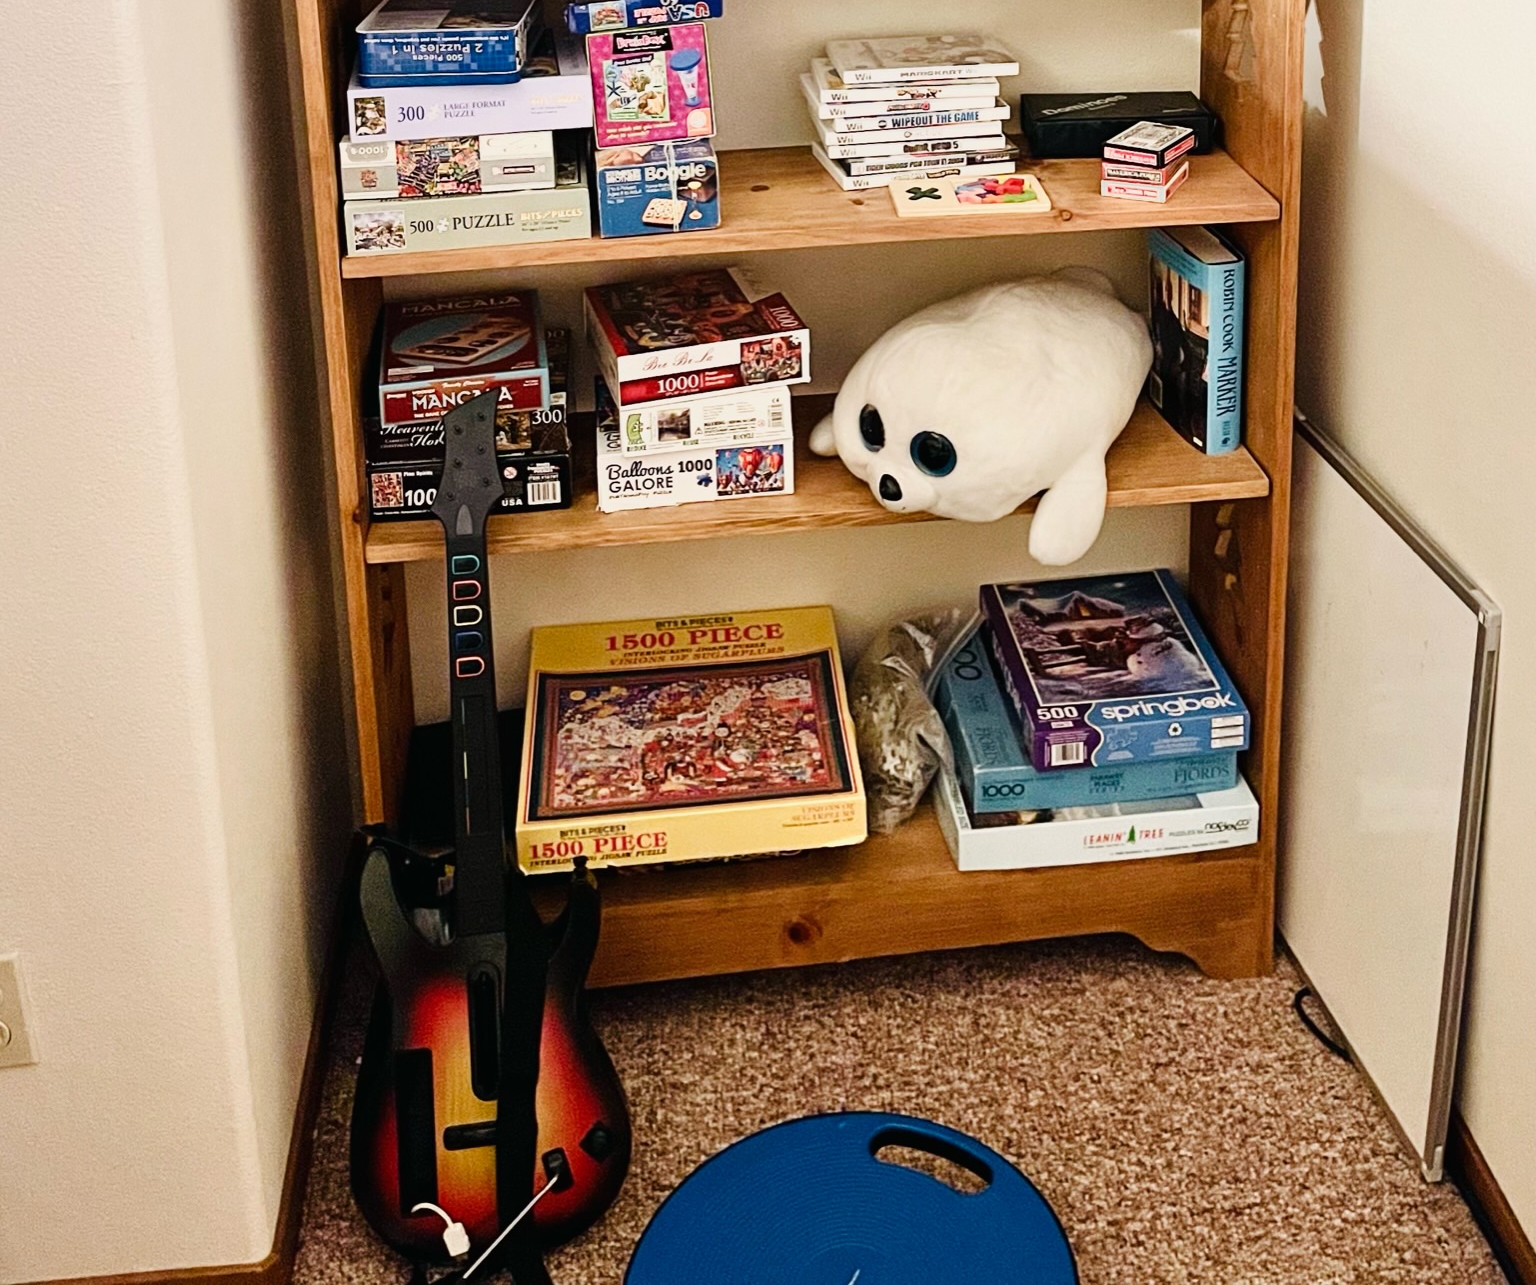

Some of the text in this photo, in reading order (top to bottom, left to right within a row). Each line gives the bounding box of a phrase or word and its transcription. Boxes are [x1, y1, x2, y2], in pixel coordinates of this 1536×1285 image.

[666, 1, 710, 22] USA
[391, 43, 483, 55] 2 Puzzles in 1
[412, 54, 463, 62] 500 Pieces
[855, 73, 872, 81] Wii
[443, 100, 506, 110] LARGE FORMAT
[831, 93, 848, 101] Wii
[829, 108, 846, 116] Wii
[1041, 95, 1128, 116] Dominoes
[397, 106, 425, 123] 300
[443, 110, 475, 118] PUZZLE
[846, 111, 979, 131] Wii WIPEOUT THE GAME
[837, 136, 853, 144] Wii
[358, 146, 385, 155] 1000
[840, 148, 857, 157] Wii
[953, 141, 959, 149] 5
[885, 162, 908, 171] WOODS
[852, 179, 869, 187] Wii
[409, 220, 434, 235] 500
[452, 212, 515, 231] PUZZLE
[1223, 268, 1235, 311] ROBIN
[401, 296, 521, 314] MANCALA
[769, 305, 799, 328] 1000
[1222, 315, 1235, 353] COOK
[657, 373, 699, 394] 1000
[1216, 356, 1238, 417] MARKER
[531, 409, 563, 425] 300
[606, 459, 713, 480] Balloons 1000
[609, 476, 673, 493] GALORE
[501, 498, 523, 506] USA
[656, 617, 728, 629] BITS & PIECES
[605, 623, 785, 652] 1500 PIECE
[609, 645, 785, 666] VISIONS OF SUGARPLUMS
[623, 642, 766, 658] INTERLOCKING JIGSAW PUZZLE
[1036, 706, 1078, 720] 500
[1101, 692, 1237, 722] springbok
[1173, 765, 1230, 784] FJORDS
[981, 783, 1025, 798] 1000
[559, 828, 580, 838] BITS
[588, 825, 621, 834] PIECES
[1138, 827, 1164, 840] TREE
[529, 831, 668, 860] 1500 PIECE
[600, 852, 632, 861] JIGSAW
[635, 848, 668, 857] PUZZLE
